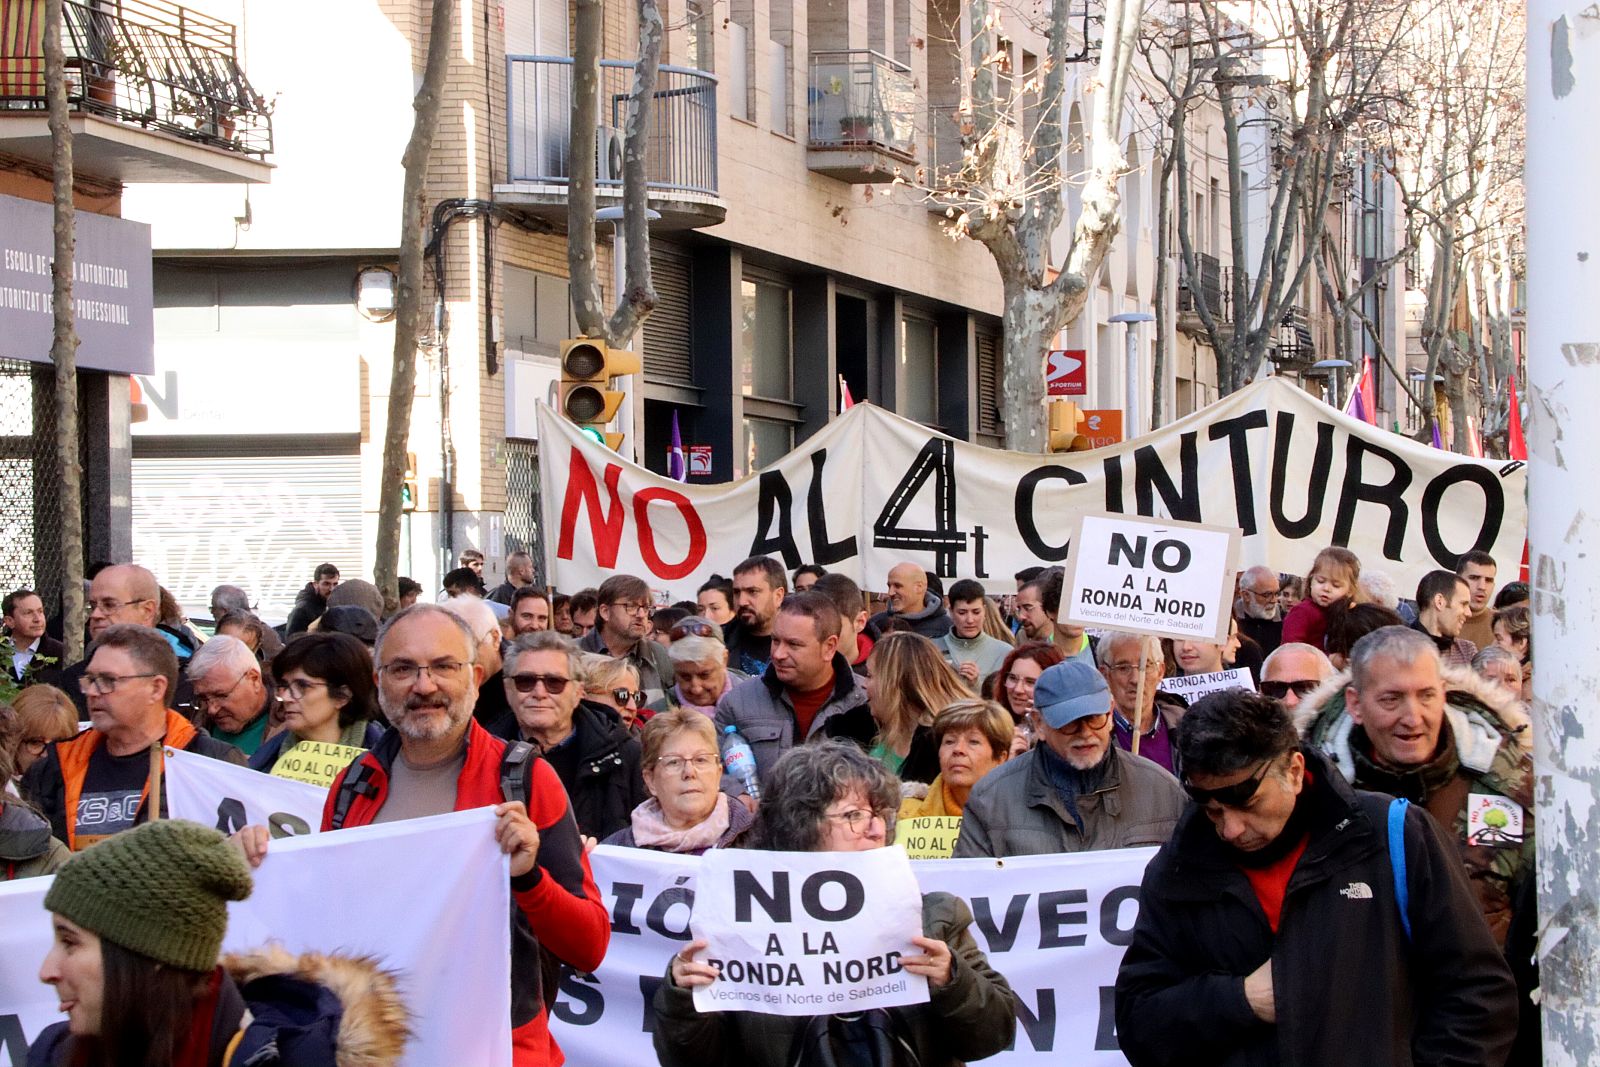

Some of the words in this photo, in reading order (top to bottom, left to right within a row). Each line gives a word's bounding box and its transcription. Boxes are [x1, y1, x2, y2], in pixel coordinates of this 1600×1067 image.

[4, 249, 34, 274] ESCOLA
[36, 255, 47, 276] DE
[79, 262, 129, 289] AUTORITZADA
[77, 299, 130, 325] PROFESSIONAL
[556, 444, 708, 581] NO
[748, 447, 858, 571] AL
[1014, 408, 1526, 572] CINTURÓ
[1107, 532, 1192, 574] NO
[1122, 573, 1135, 590] A
[1145, 576, 1169, 594] LA
[1080, 588, 1143, 611] RONDA
[1153, 597, 1206, 619] NORD
[1079, 607, 1112, 620] Vecinos
[1113, 610, 1127, 621] del
[1128, 613, 1152, 625] Norte
[1153, 615, 1165, 626] de
[1166, 617, 1204, 631] Sabadell
[1169, 675, 1207, 690] RONDA
[1208, 670, 1239, 683] NORD
[311, 743, 321, 754] A
[324, 744, 341, 758] LA
[281, 759, 302, 772] NO
[303, 761, 321, 775] AL
[912, 818, 931, 829] NO
[934, 818, 944, 829] A
[906, 837, 926, 850] NO
[930, 837, 948, 851] AL
[732, 869, 866, 923] NO
[764, 933, 785, 957] A
[802, 931, 840, 956] LA
[707, 958, 805, 987] RONDA
[823, 950, 904, 985] NORD
[709, 988, 761, 1001] Vecinos
[763, 991, 783, 1004] del
[786, 993, 823, 1005] Norte
[826, 988, 845, 1001] de
[848, 980, 907, 1000] Sabadell
